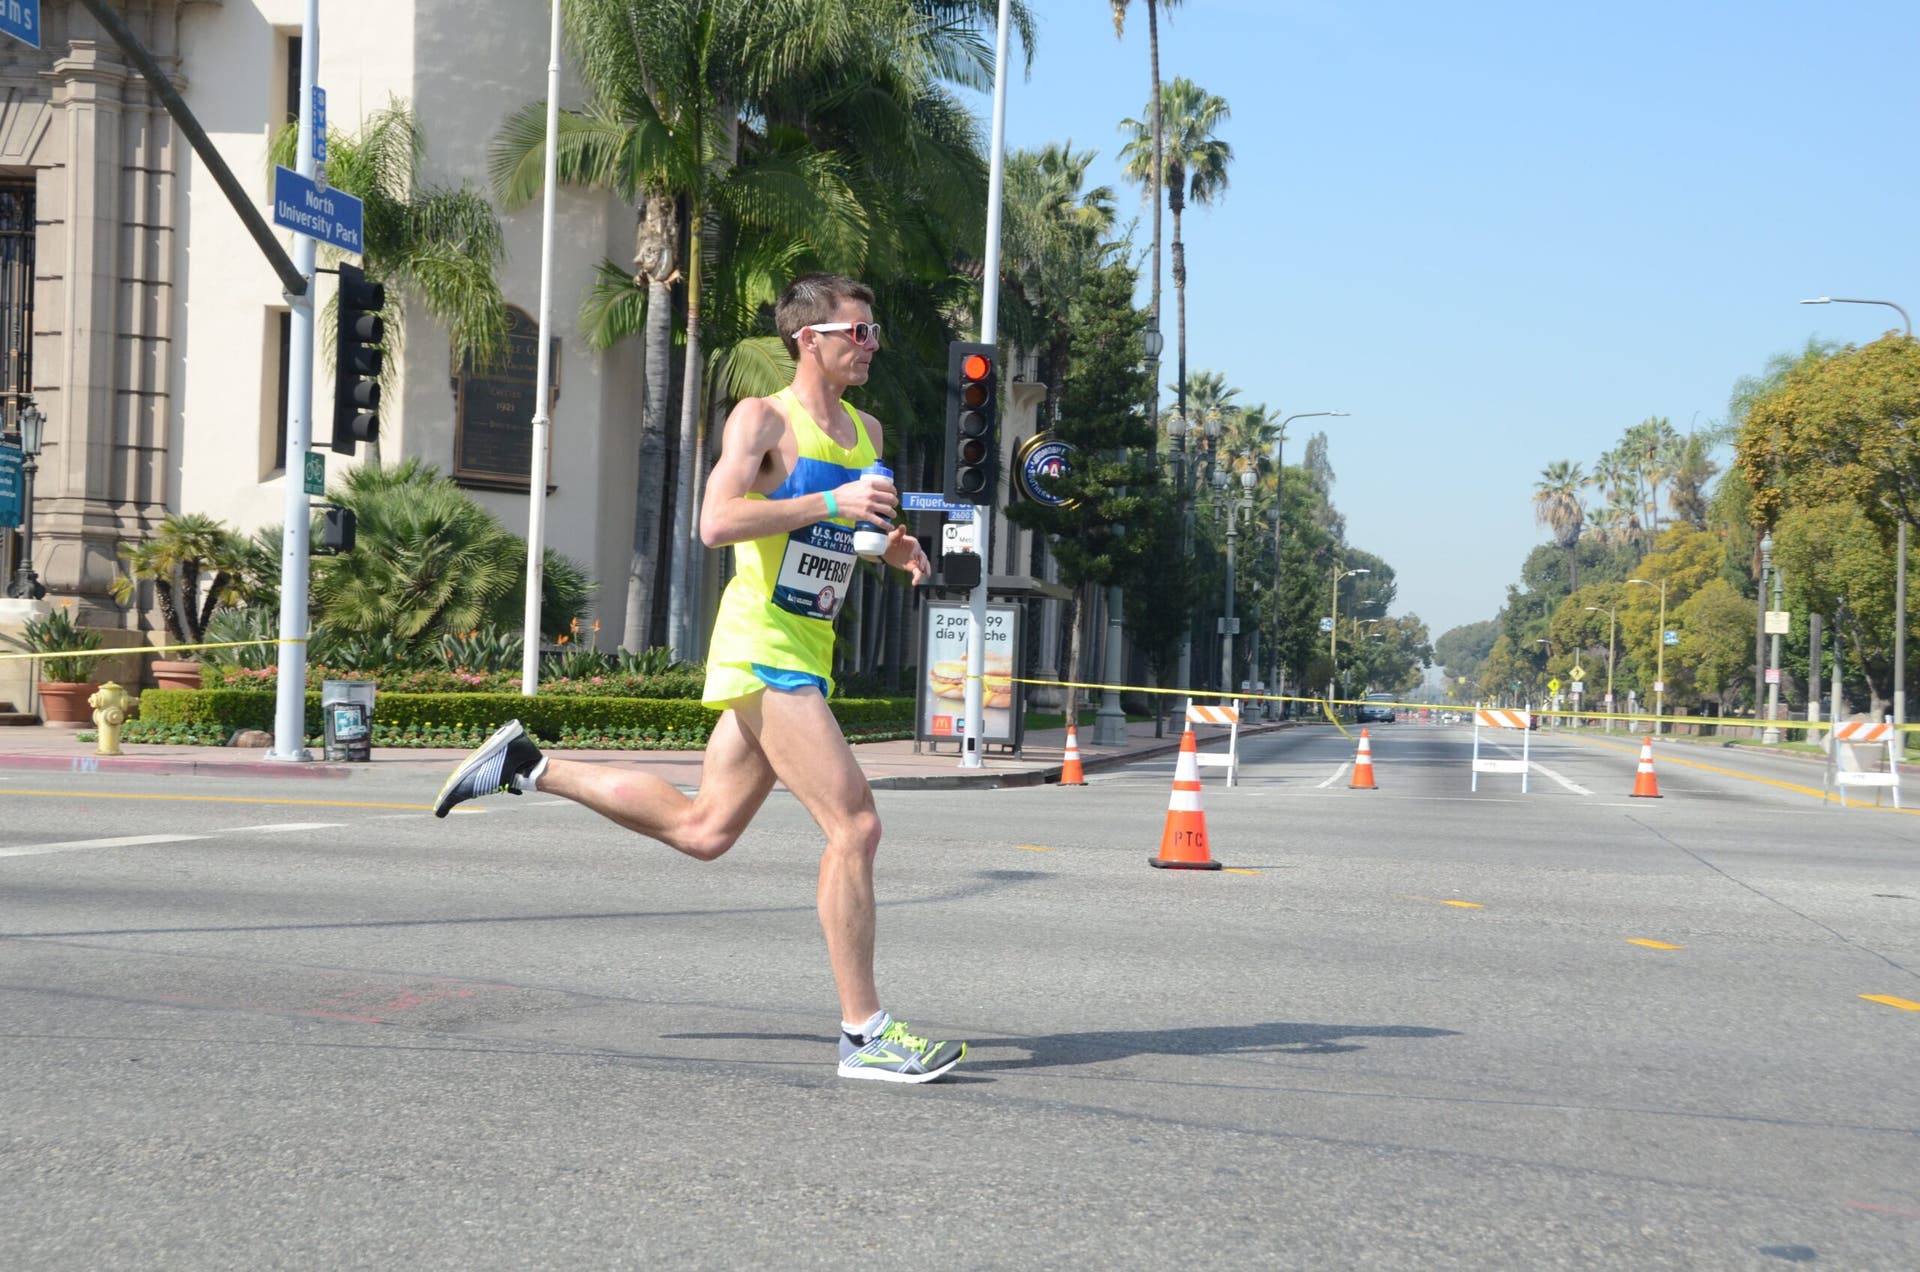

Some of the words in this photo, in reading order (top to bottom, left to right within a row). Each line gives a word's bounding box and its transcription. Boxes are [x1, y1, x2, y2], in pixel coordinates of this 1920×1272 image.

[305, 189, 335, 216] North
[278, 199, 333, 239] University
[335, 221, 358, 246] Park
[951, 511, 970, 519] 2600
[812, 525, 832, 540] U.S.
[834, 531, 855, 545] OLYM
[810, 536, 836, 550] TEAM
[936, 614, 944, 625] 2
[947, 617, 968, 627] por
[984, 616, 1003, 627] .99
[958, 631, 965, 642] y
[984, 630, 1007, 641] che
[1174, 831, 1203, 848] PTC
